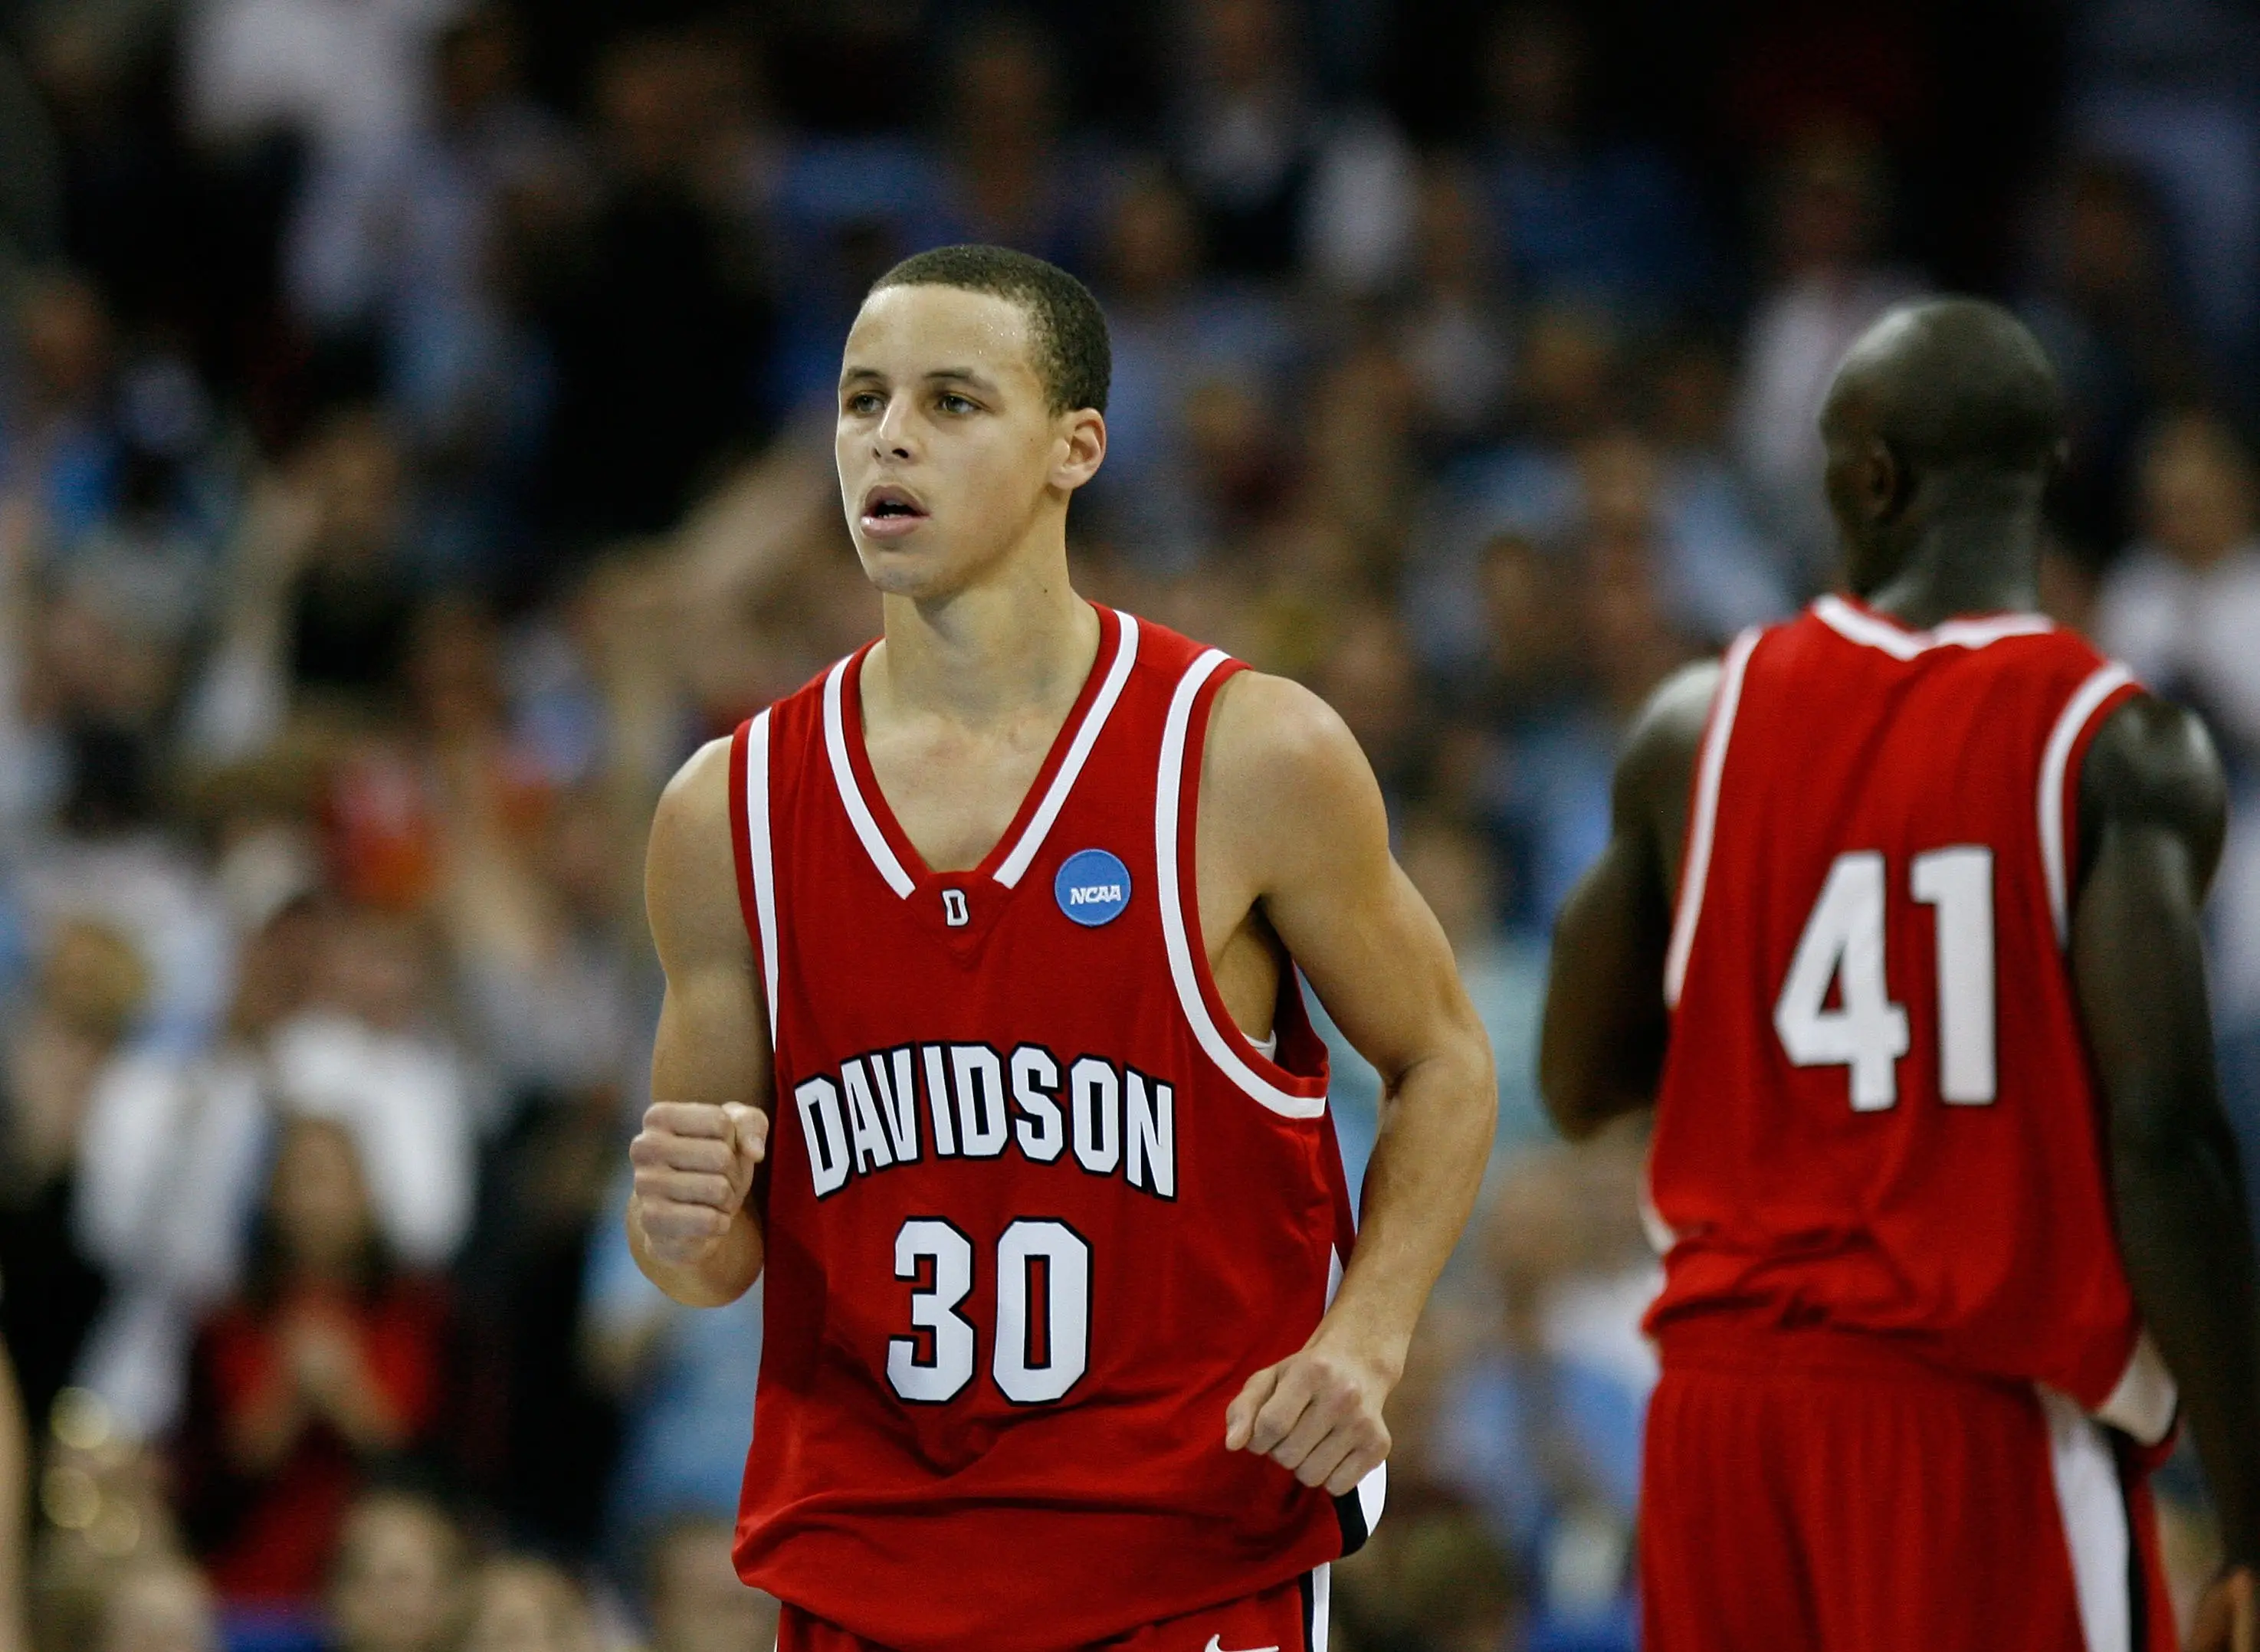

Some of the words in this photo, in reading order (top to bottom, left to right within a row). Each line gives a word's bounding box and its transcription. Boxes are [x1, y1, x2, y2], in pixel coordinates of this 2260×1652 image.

[941, 888, 969, 926] D
[1070, 884, 1121, 905] NCAA
[1773, 845, 1998, 1113] 41
[793, 1041, 1177, 1201] DAVIDSON
[885, 1217, 1093, 1407] 30
